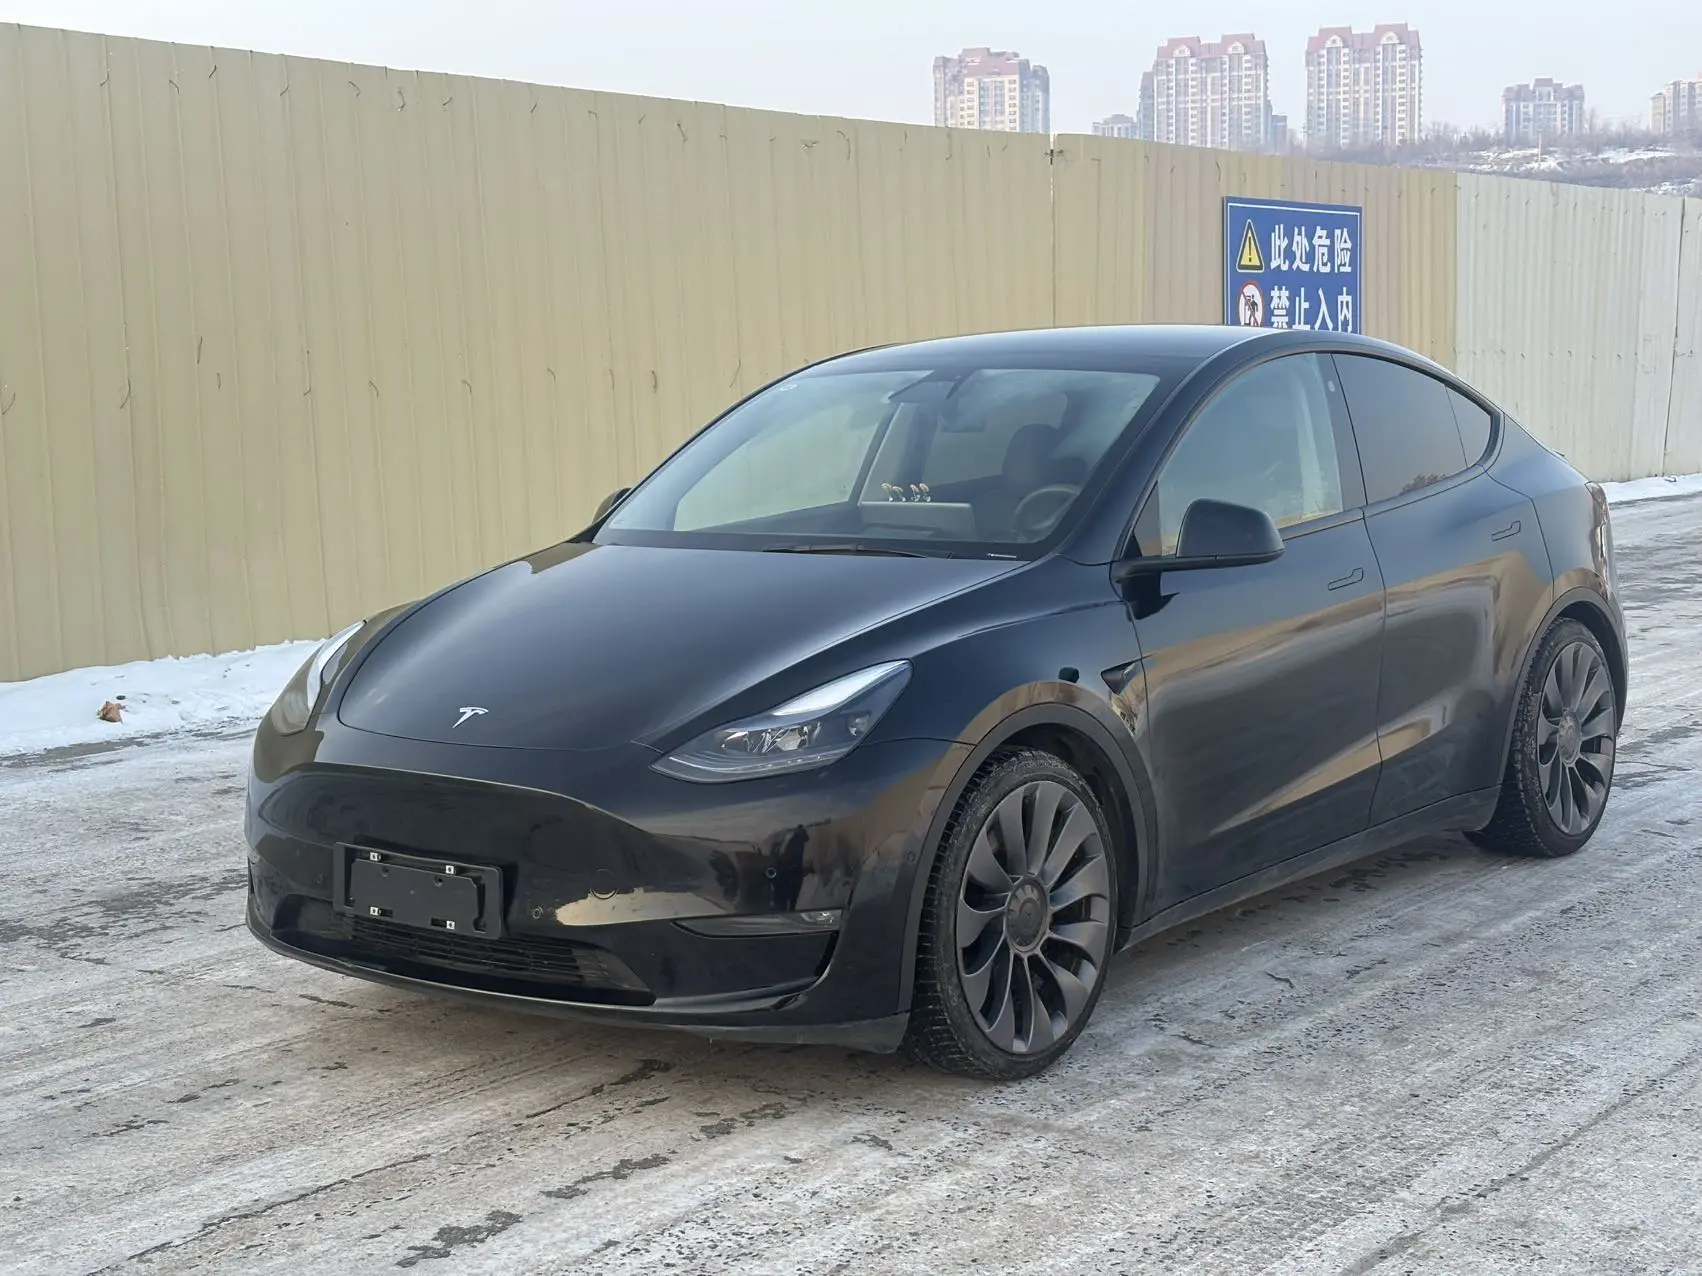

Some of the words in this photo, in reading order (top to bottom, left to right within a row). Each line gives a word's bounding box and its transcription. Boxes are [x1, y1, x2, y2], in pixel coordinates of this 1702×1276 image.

[1270, 223, 1352, 273] 此处危险
[1270, 285, 1352, 332] 禁止入内
